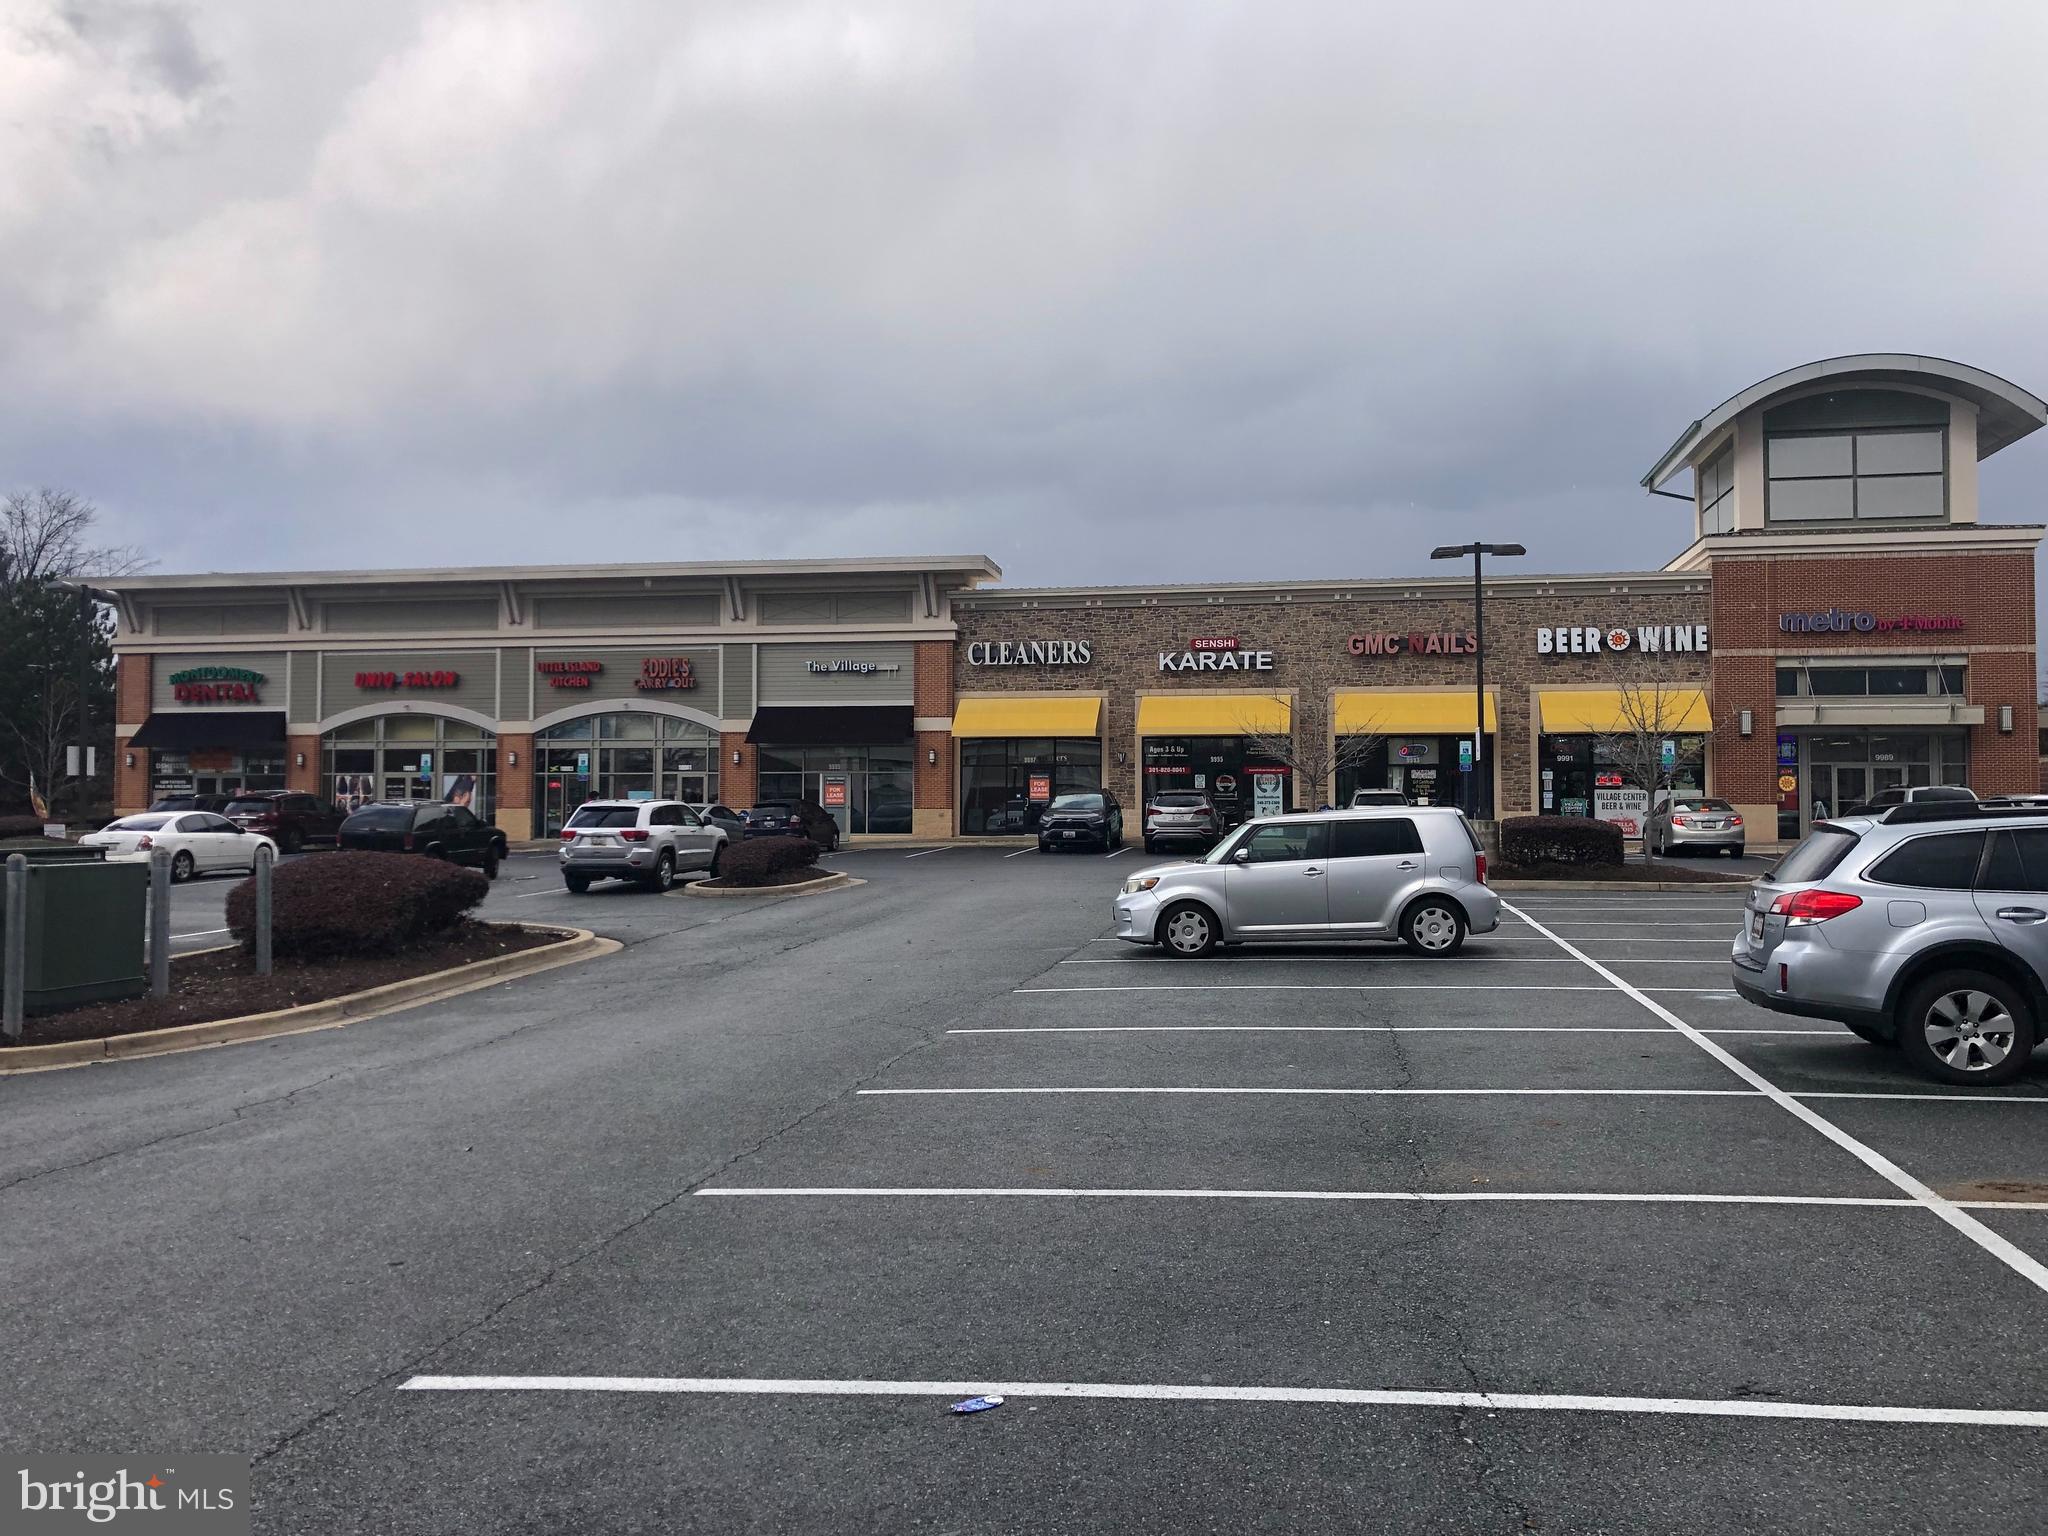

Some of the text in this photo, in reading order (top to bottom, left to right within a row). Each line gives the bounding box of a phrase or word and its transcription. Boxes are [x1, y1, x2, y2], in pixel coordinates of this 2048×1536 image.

[1779, 608, 1876, 632] metro
[1878, 618, 1894, 633] by
[1195, 639, 1235, 648] SENSHI
[1348, 631, 1478, 655] GMC NAILS
[1537, 625, 1708, 653] BEER WINE
[967, 639, 1092, 666] CLEANERS
[1159, 651, 1273, 671] KARATE
[567, 660, 601, 672] ISLAND
[640, 657, 690, 677] EDDIE'S
[805, 660, 876, 673] The Village
[168, 666, 265, 685] MONTGOMERY
[401, 670, 459, 688] SALON
[548, 676, 590, 687] KITCHEN
[673, 677, 696, 688] OUT
[174, 683, 257, 702] DENTAL
[1149, 745, 1164, 753] Ages
[1596, 792, 1647, 801] VILLAGE CENTER
[1601, 802, 1618, 810] BEER
[1625, 802, 1642, 811] WINE
